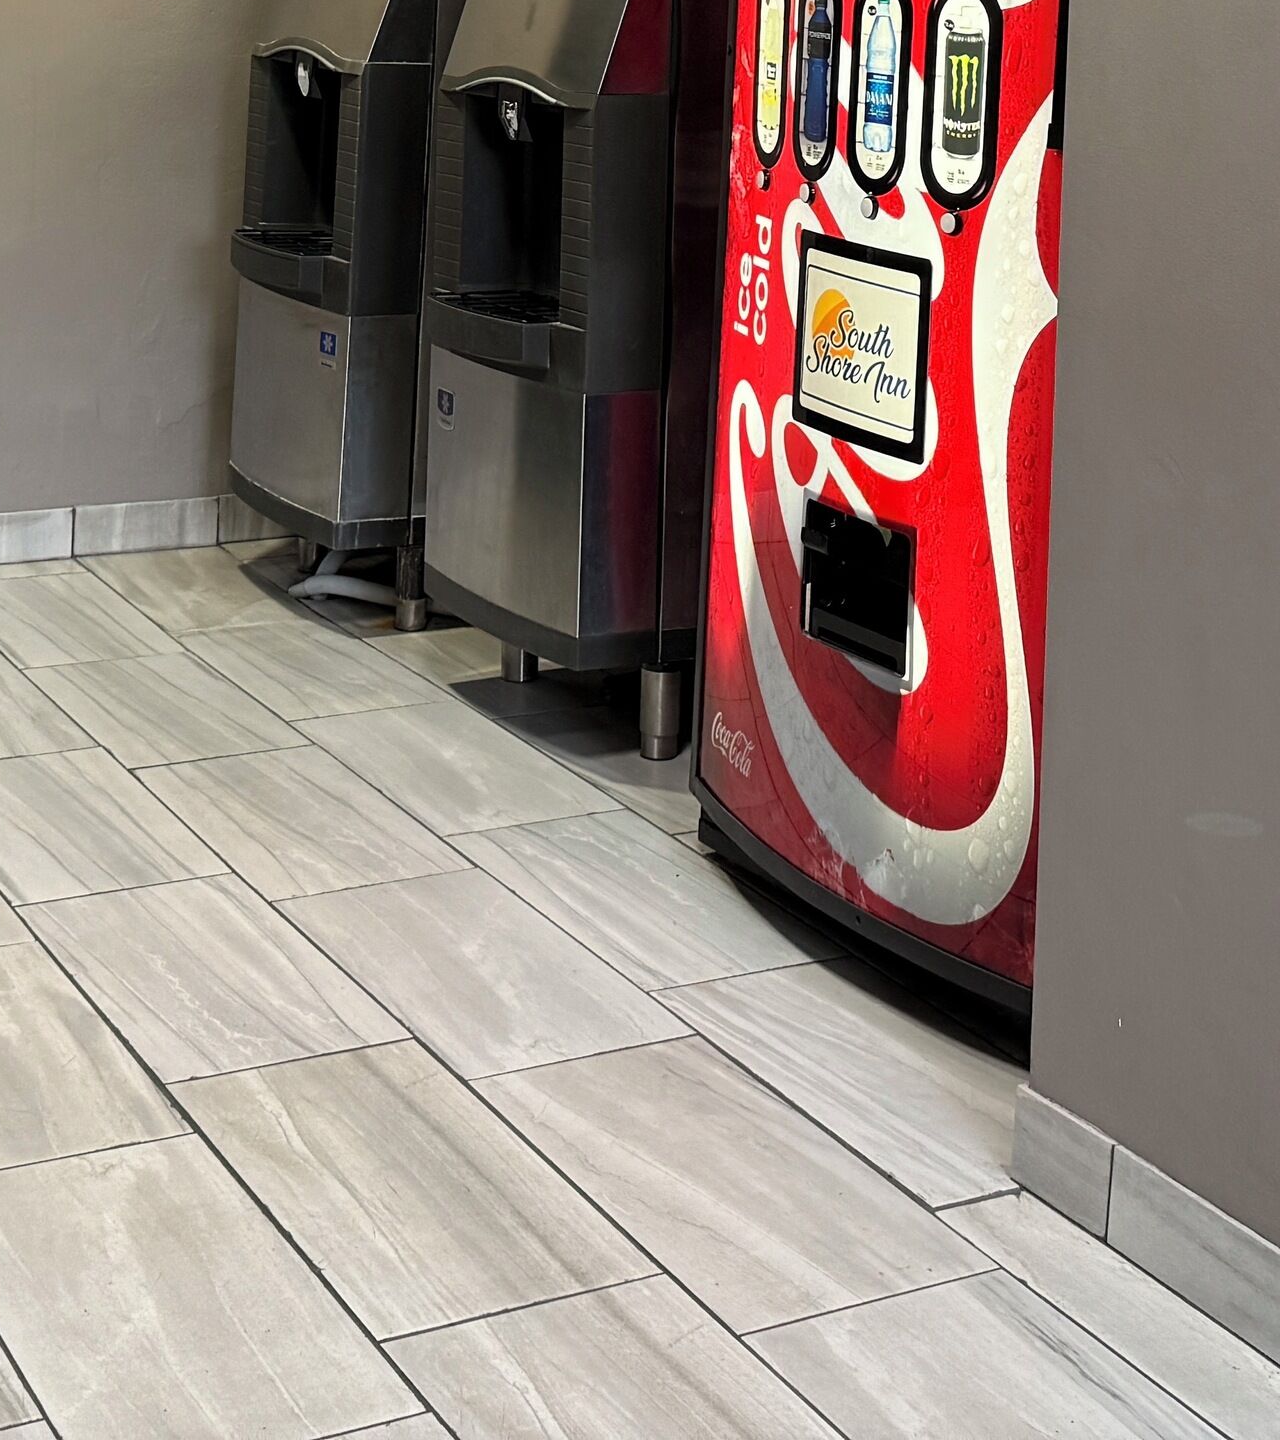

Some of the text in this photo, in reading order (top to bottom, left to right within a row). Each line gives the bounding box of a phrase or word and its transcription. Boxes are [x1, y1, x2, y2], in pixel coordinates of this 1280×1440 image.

[733, 252, 753, 337] ice
[753, 214, 773, 346] cold
[805, 334, 912, 404] Shore Inn
[830, 309, 895, 360] South
[710, 709, 756, 778] Coca-Cola
